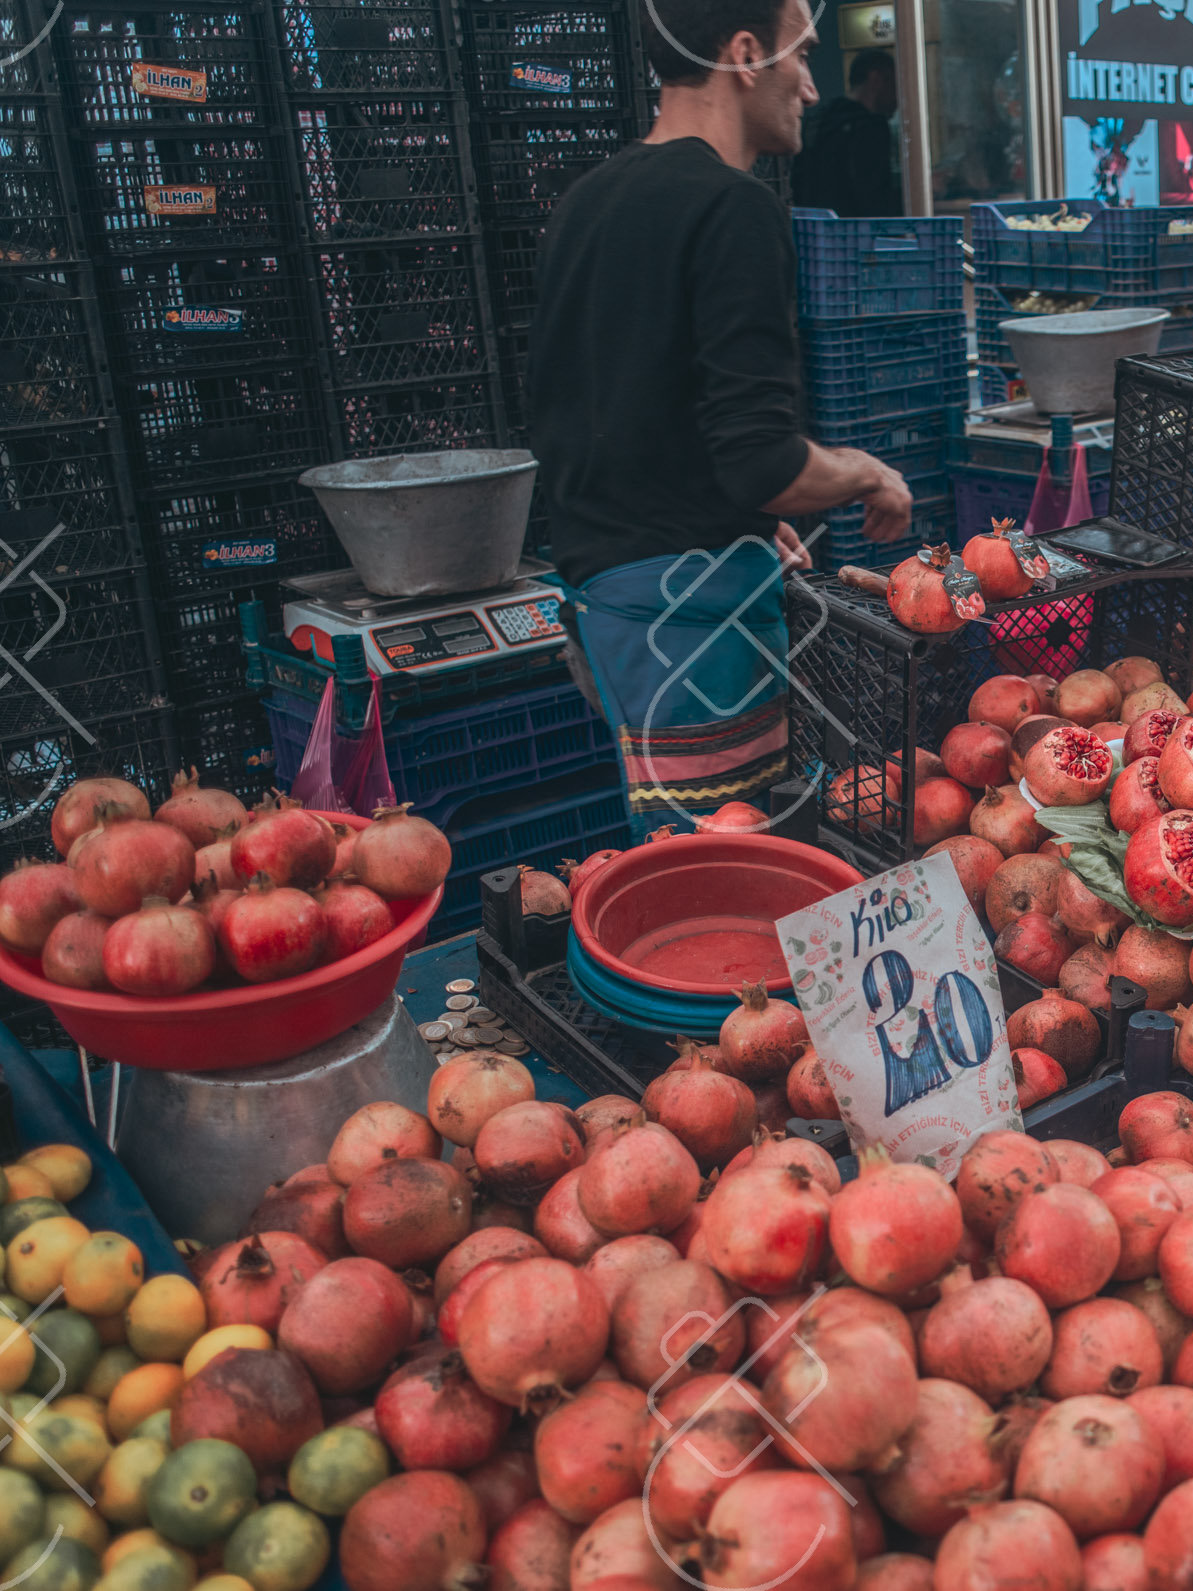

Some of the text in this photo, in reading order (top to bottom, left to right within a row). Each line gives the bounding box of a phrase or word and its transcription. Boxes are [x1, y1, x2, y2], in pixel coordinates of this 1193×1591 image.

[146, 68, 193, 90] İLHAN
[1067, 51, 1179, 104] İNTERNET
[159, 189, 204, 205] İLHAN
[861, 949, 994, 1118] 20
